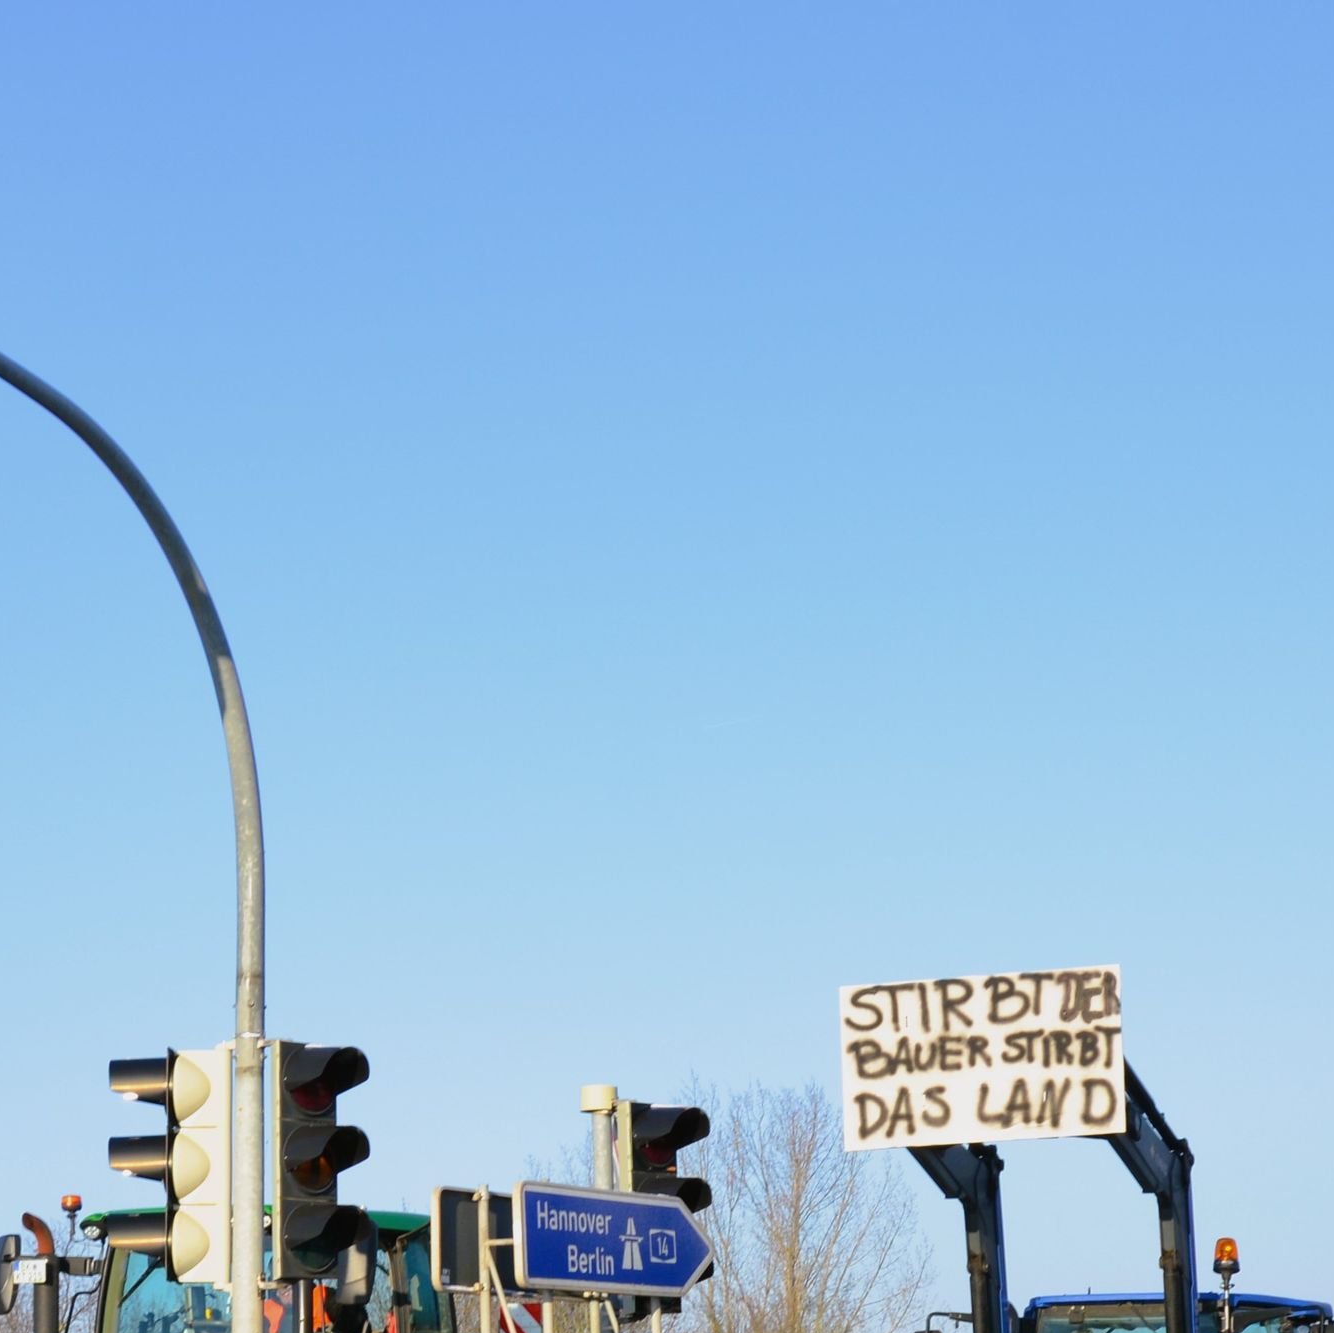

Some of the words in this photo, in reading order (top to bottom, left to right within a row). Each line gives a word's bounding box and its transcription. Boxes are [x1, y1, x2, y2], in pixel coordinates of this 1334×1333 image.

[844, 972, 1054, 1032] STIRBT
[1056, 970, 1121, 1024] DER
[846, 1034, 993, 1080] BAUER
[1001, 1026, 1122, 1068] STIRBT
[853, 1085, 951, 1140] DAS
[976, 1077, 1118, 1129] LAND
[537, 1200, 612, 1235] Hannover
[568, 1244, 615, 1276] Berlin
[657, 1236, 669, 1258] 14
